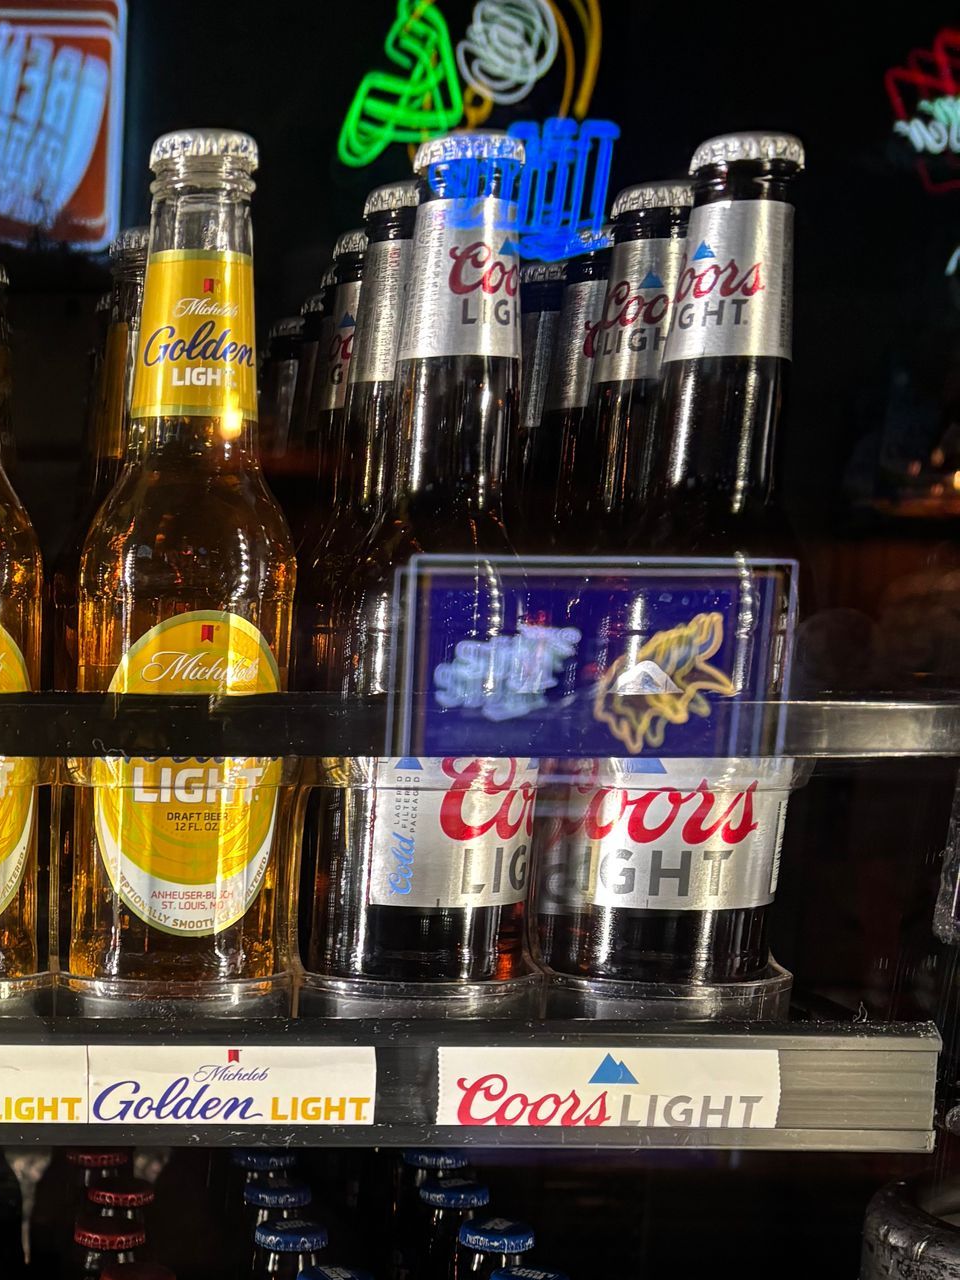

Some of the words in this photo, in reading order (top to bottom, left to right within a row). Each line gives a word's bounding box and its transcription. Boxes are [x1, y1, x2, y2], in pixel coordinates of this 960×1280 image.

[143, 320, 254, 367] Golden
[171, 367, 237, 387] LIGHT
[140, 650, 259, 683] Michelob
[133, 766, 264, 804] LIGHT
[167, 811, 203, 822] DRAFT
[204, 811, 229, 822] BEER
[174, 822, 186, 832] 12
[187, 822, 204, 832] FL.
[204, 822, 220, 832] OZ.
[387, 831, 416, 896] Cold
[150, 889, 234, 900] ANHEUSER-BUSCH
[161, 900, 177, 910] ST.
[178, 900, 209, 911] LOUIS,
[192, 1064, 269, 1083] Michelob
[92, 1076, 264, 1121] Golden
[271, 1097, 368, 1121] LIGHT
[456, 1073, 611, 1126] Coors
[620, 1094, 764, 1128] LIGHT
